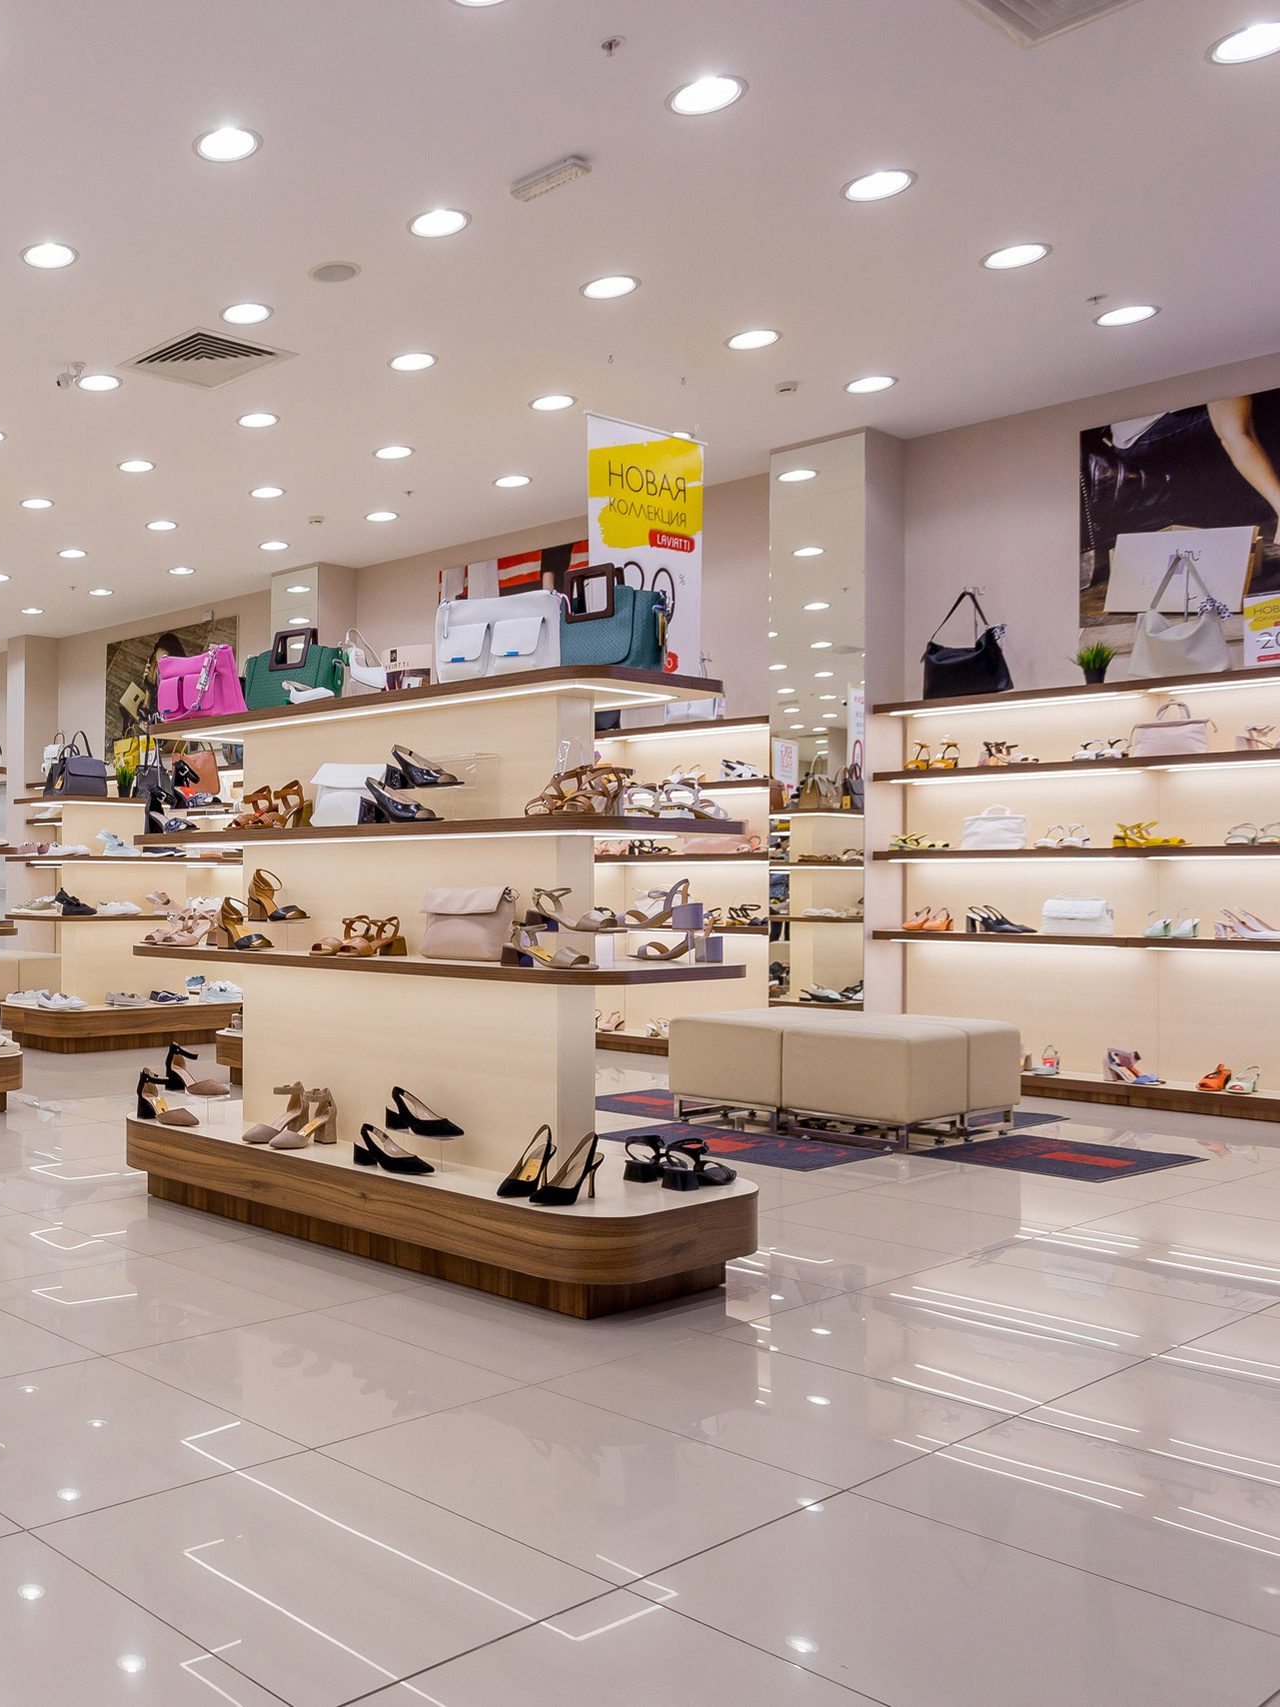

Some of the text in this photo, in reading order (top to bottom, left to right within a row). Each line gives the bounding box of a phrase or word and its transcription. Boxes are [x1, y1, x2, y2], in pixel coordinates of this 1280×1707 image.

[608, 460, 687, 503] НОВАЯ
[609, 498, 687, 528] КОЛЛЕКЦИЯ
[656, 534, 690, 551] LAVIATTI
[1254, 604, 1280, 615] НОВ
